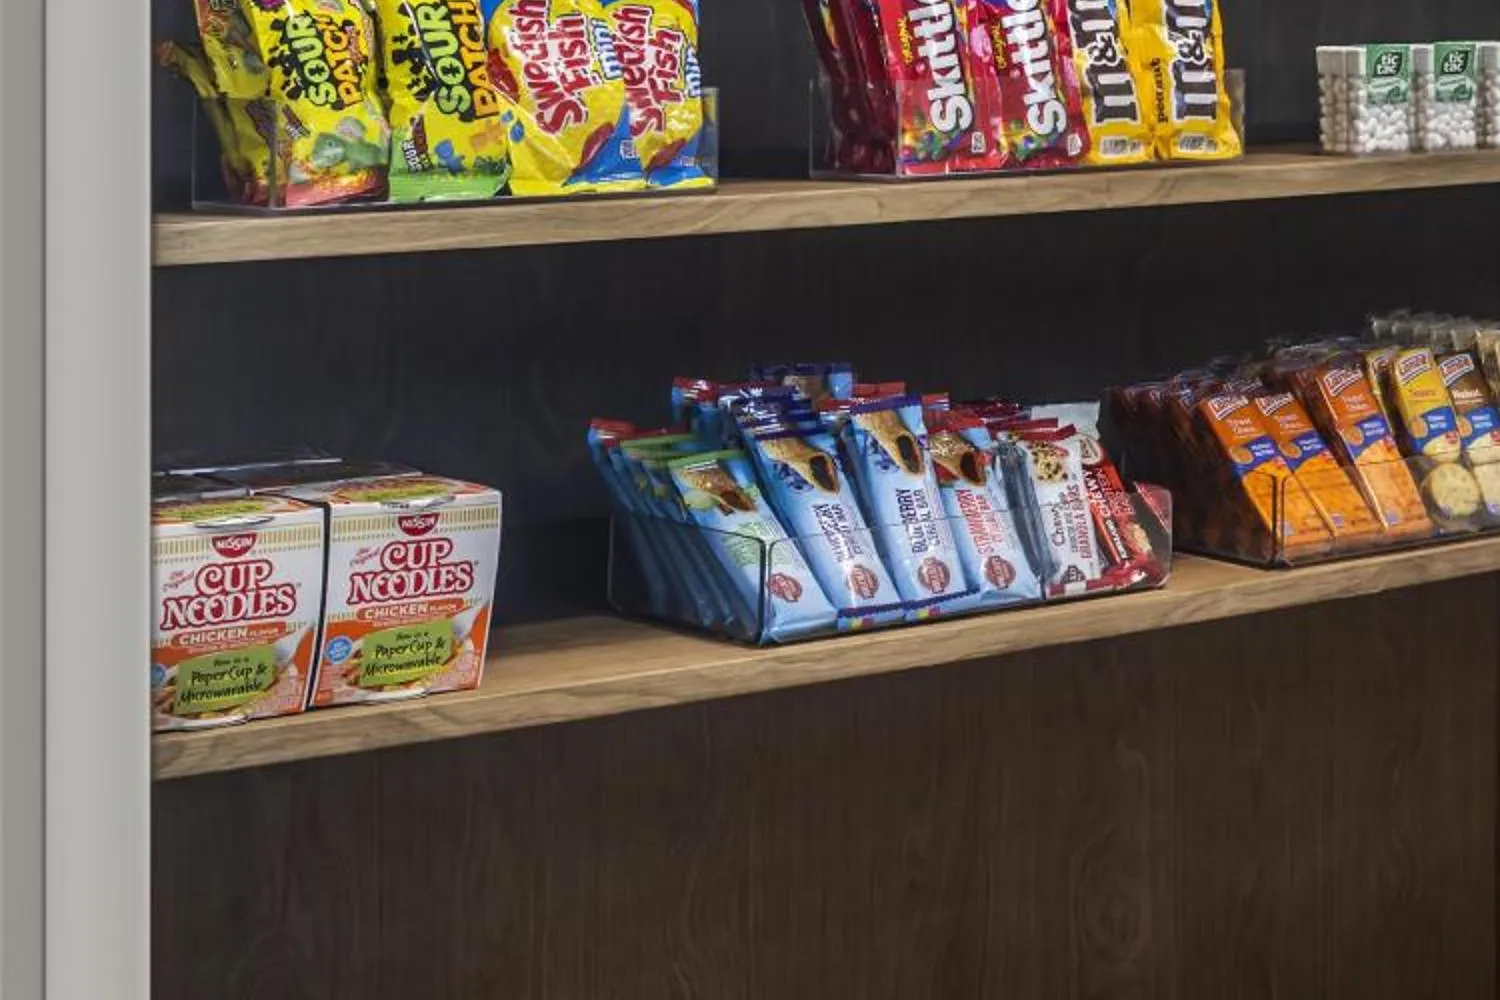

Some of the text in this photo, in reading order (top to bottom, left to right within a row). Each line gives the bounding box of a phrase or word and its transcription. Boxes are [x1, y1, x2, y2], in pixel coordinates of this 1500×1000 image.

[285, 13, 338, 107] SOUR
[415, 2, 471, 115] SOUR
[548, 13, 592, 94] Fish
[650, 27, 686, 105] Fish
[1376, 61, 1396, 75] tac
[1382, 52, 1400, 66] tic
[1443, 60, 1464, 74] tac
[1449, 50, 1465, 64] tic
[380, 537, 454, 572] CUP
[196, 559, 273, 595] CUP
[346, 560, 475, 605] NOODLES
[160, 584, 296, 631] NOODLES
[364, 603, 429, 620] CHICKEN
[178, 628, 248, 646] CHICKEN
